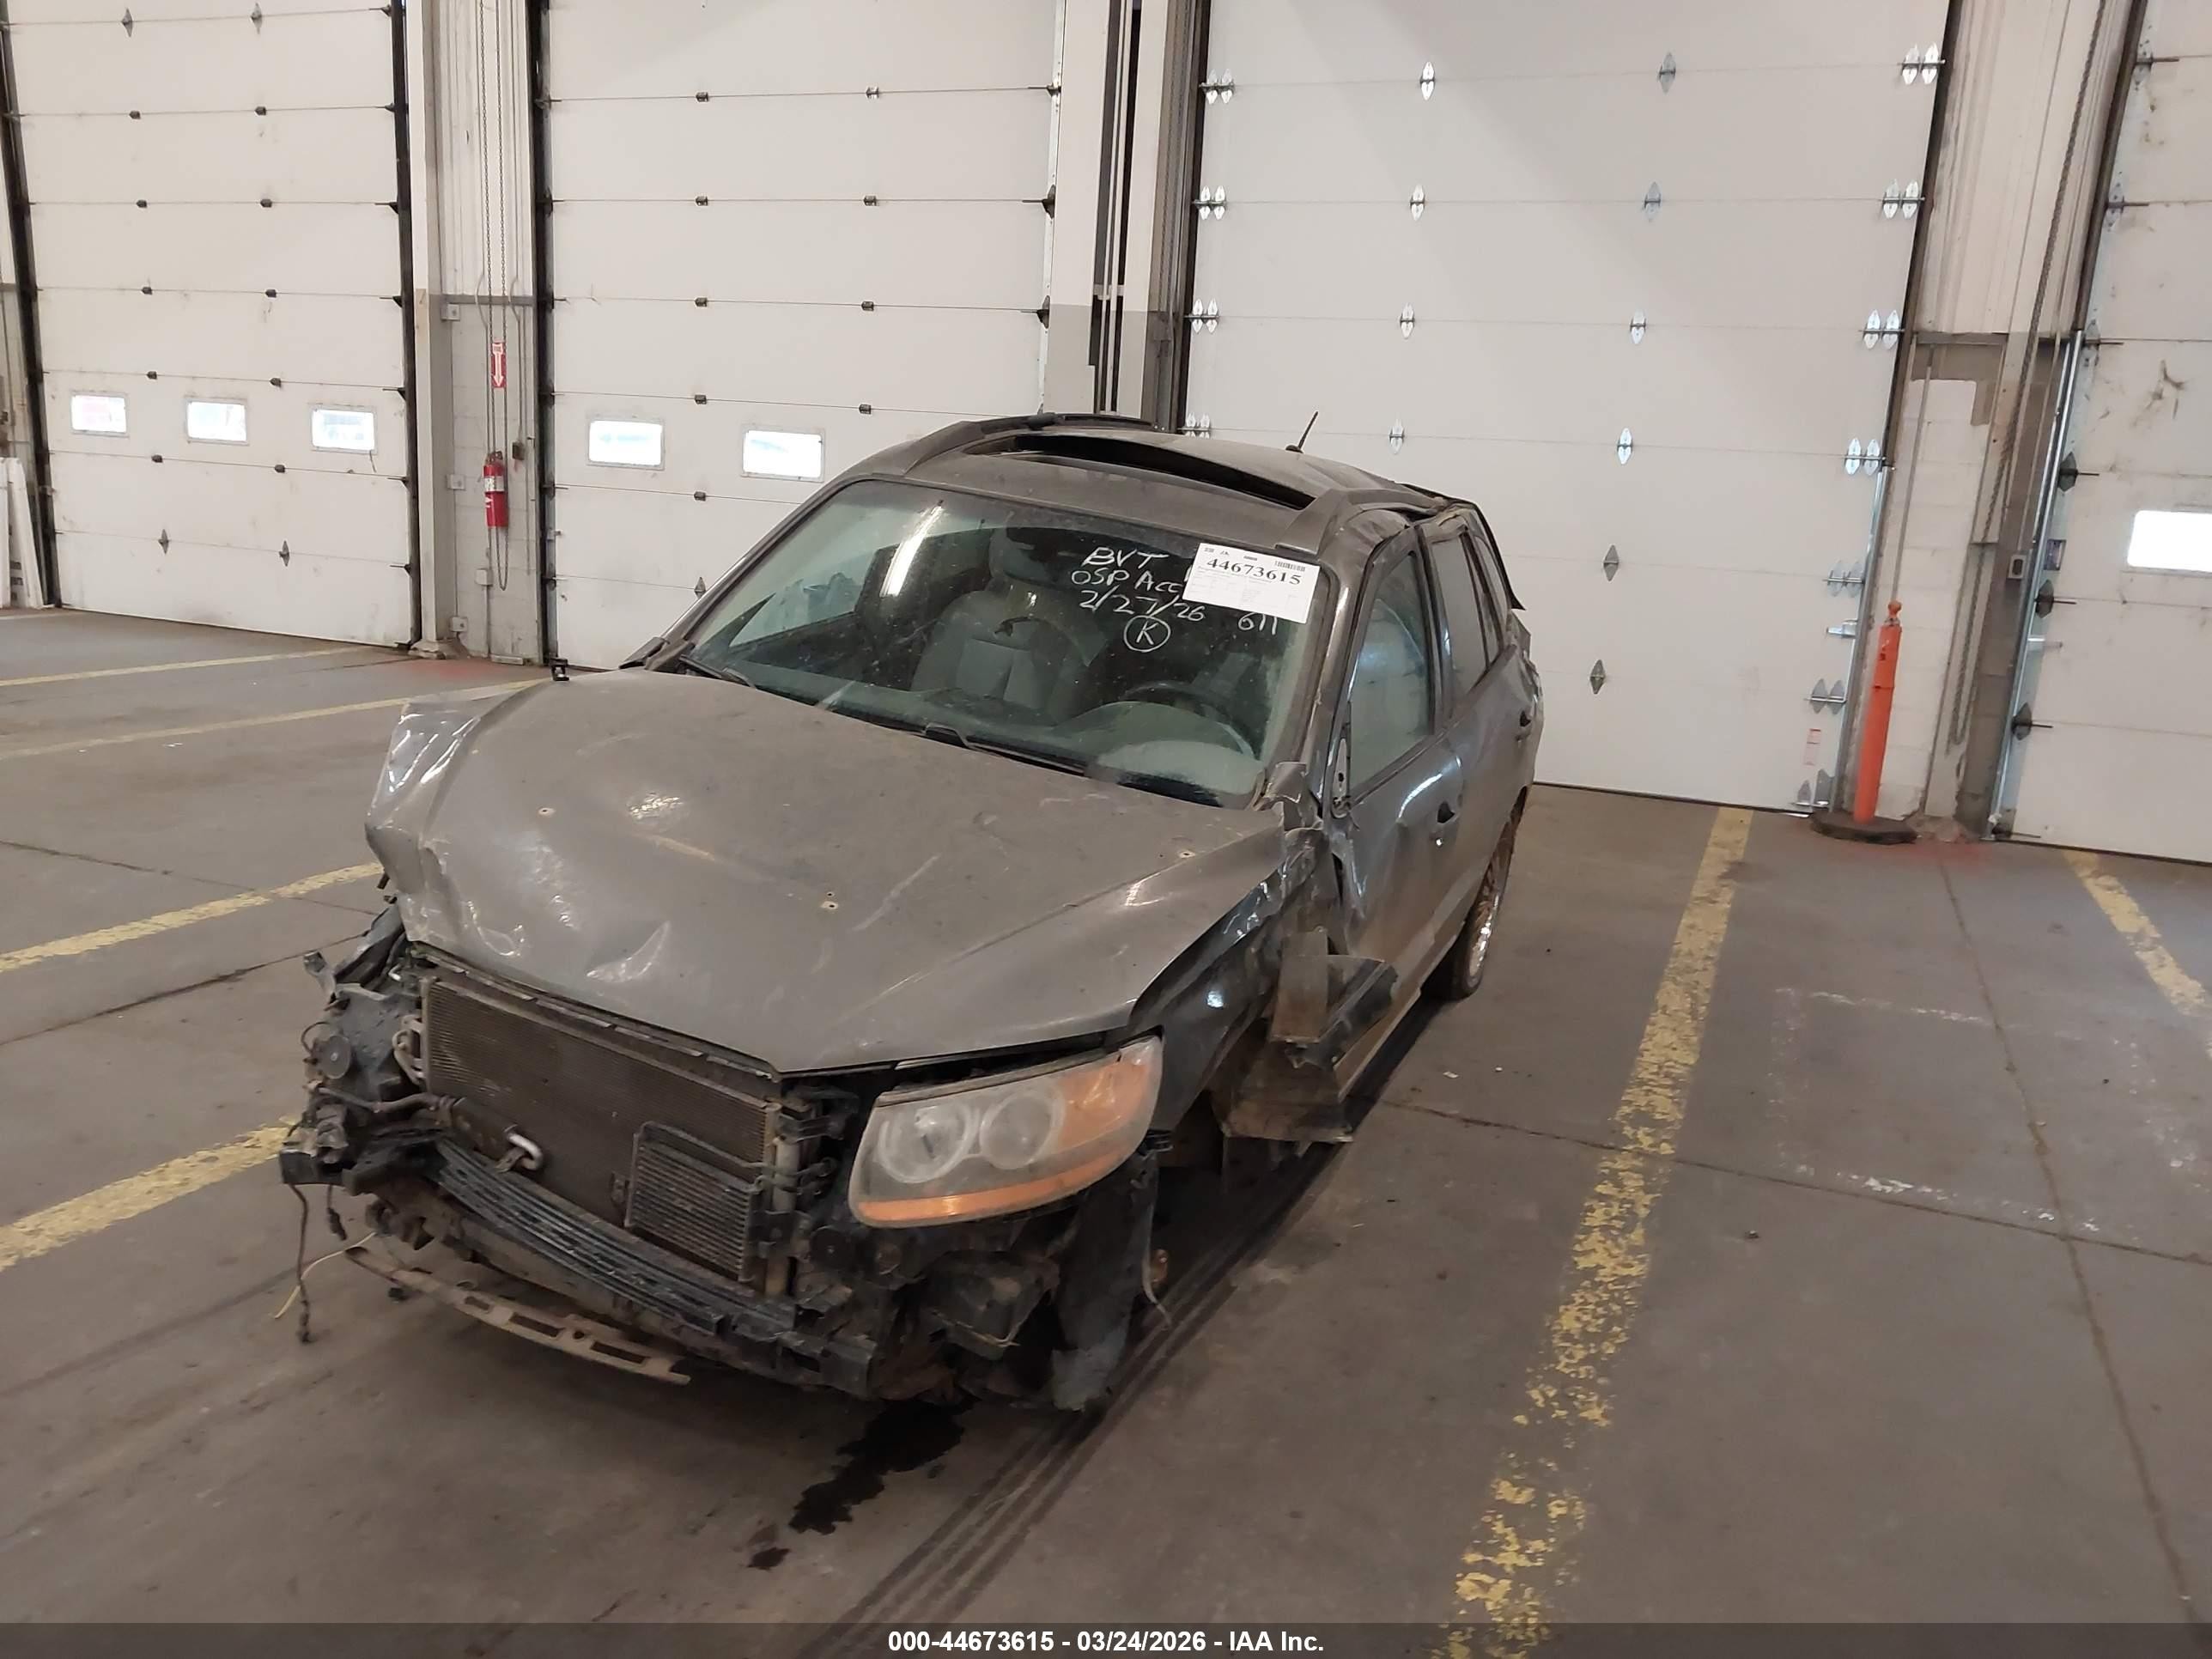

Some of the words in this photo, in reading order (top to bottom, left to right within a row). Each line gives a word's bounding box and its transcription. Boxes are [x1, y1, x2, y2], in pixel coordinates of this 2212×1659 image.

[1081, 546, 1169, 568] BVT
[1206, 558, 1302, 586] 44673615
[1135, 621, 1159, 646] K
